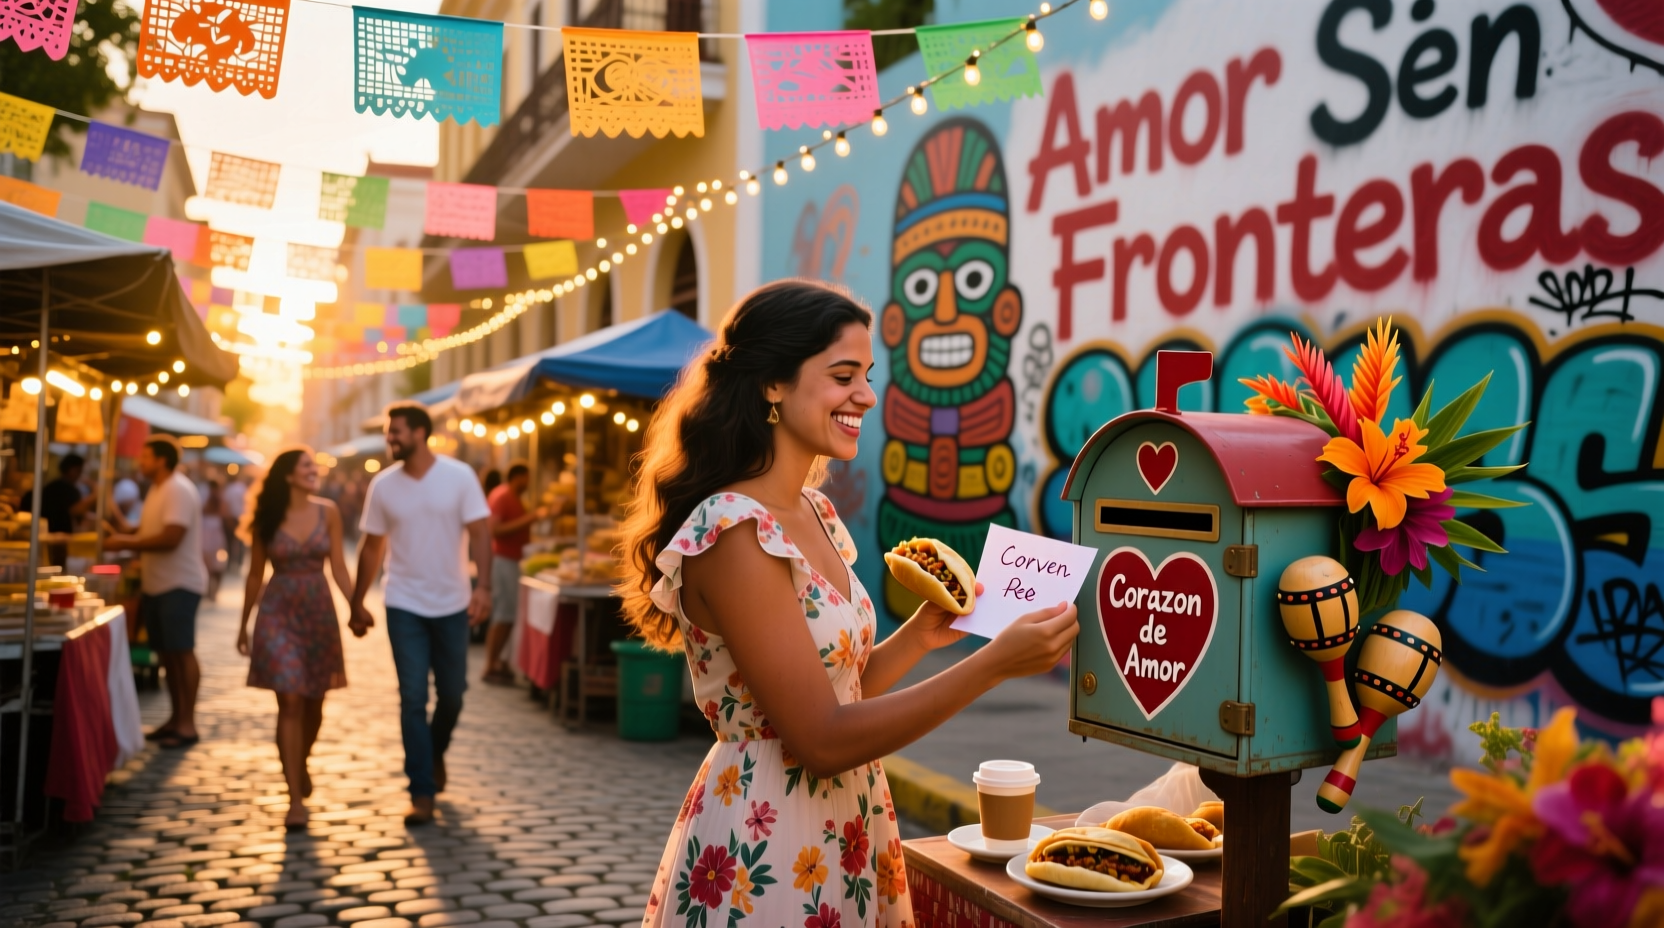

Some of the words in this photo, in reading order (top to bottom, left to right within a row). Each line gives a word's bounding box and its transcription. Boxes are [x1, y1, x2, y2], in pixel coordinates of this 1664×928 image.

[1027, 48, 1281, 213] Amor
[1052, 111, 1664, 342] Fronteras
[1001, 545, 1071, 578] Corven
[1109, 573, 1202, 617] Corazon
[1139, 613, 1167, 645] de
[1123, 642, 1186, 683] Amor
